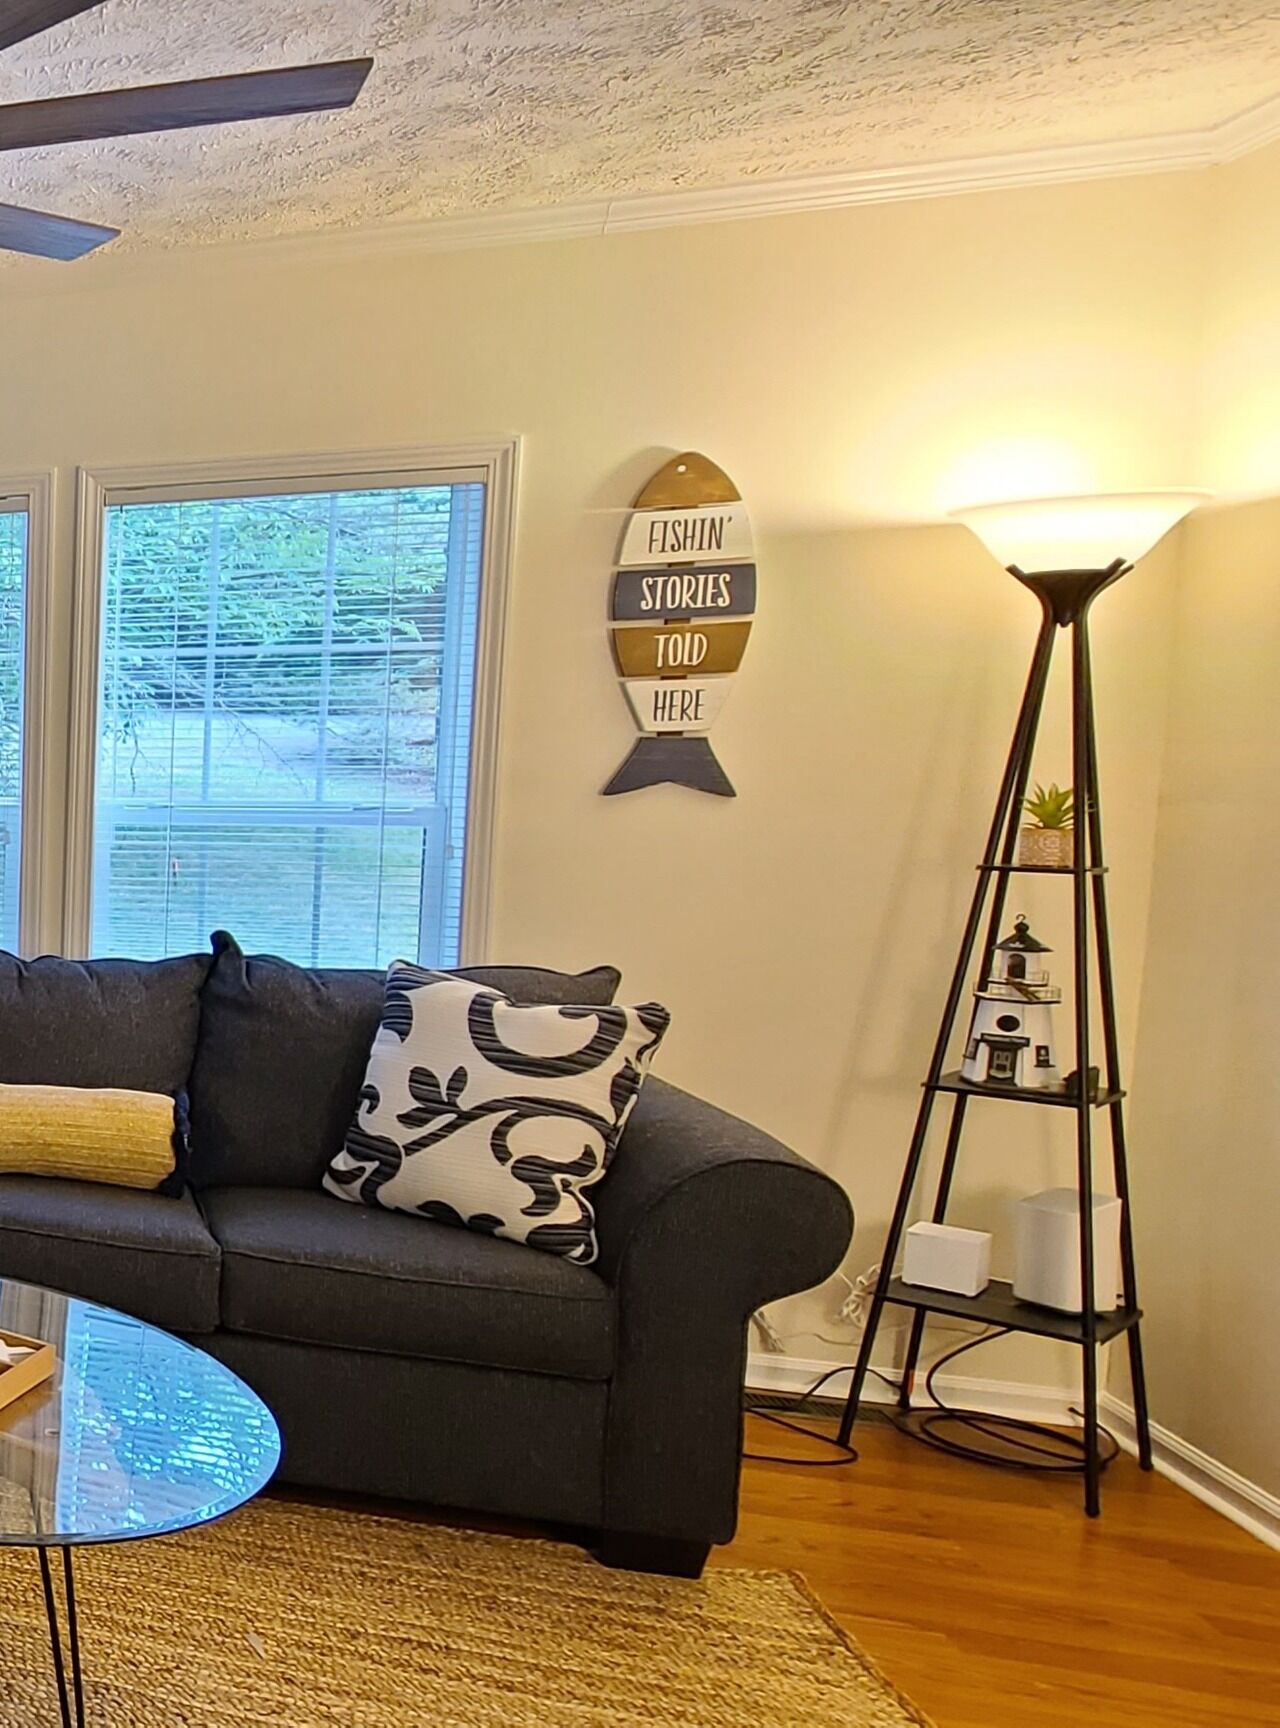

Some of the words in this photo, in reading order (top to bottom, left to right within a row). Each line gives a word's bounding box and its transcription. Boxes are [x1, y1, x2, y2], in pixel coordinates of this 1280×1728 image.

[647, 516, 733, 554] FISHIN'
[640, 573, 731, 611] STORIES
[654, 632, 707, 668] TOLD
[653, 688, 706, 722] HERE
